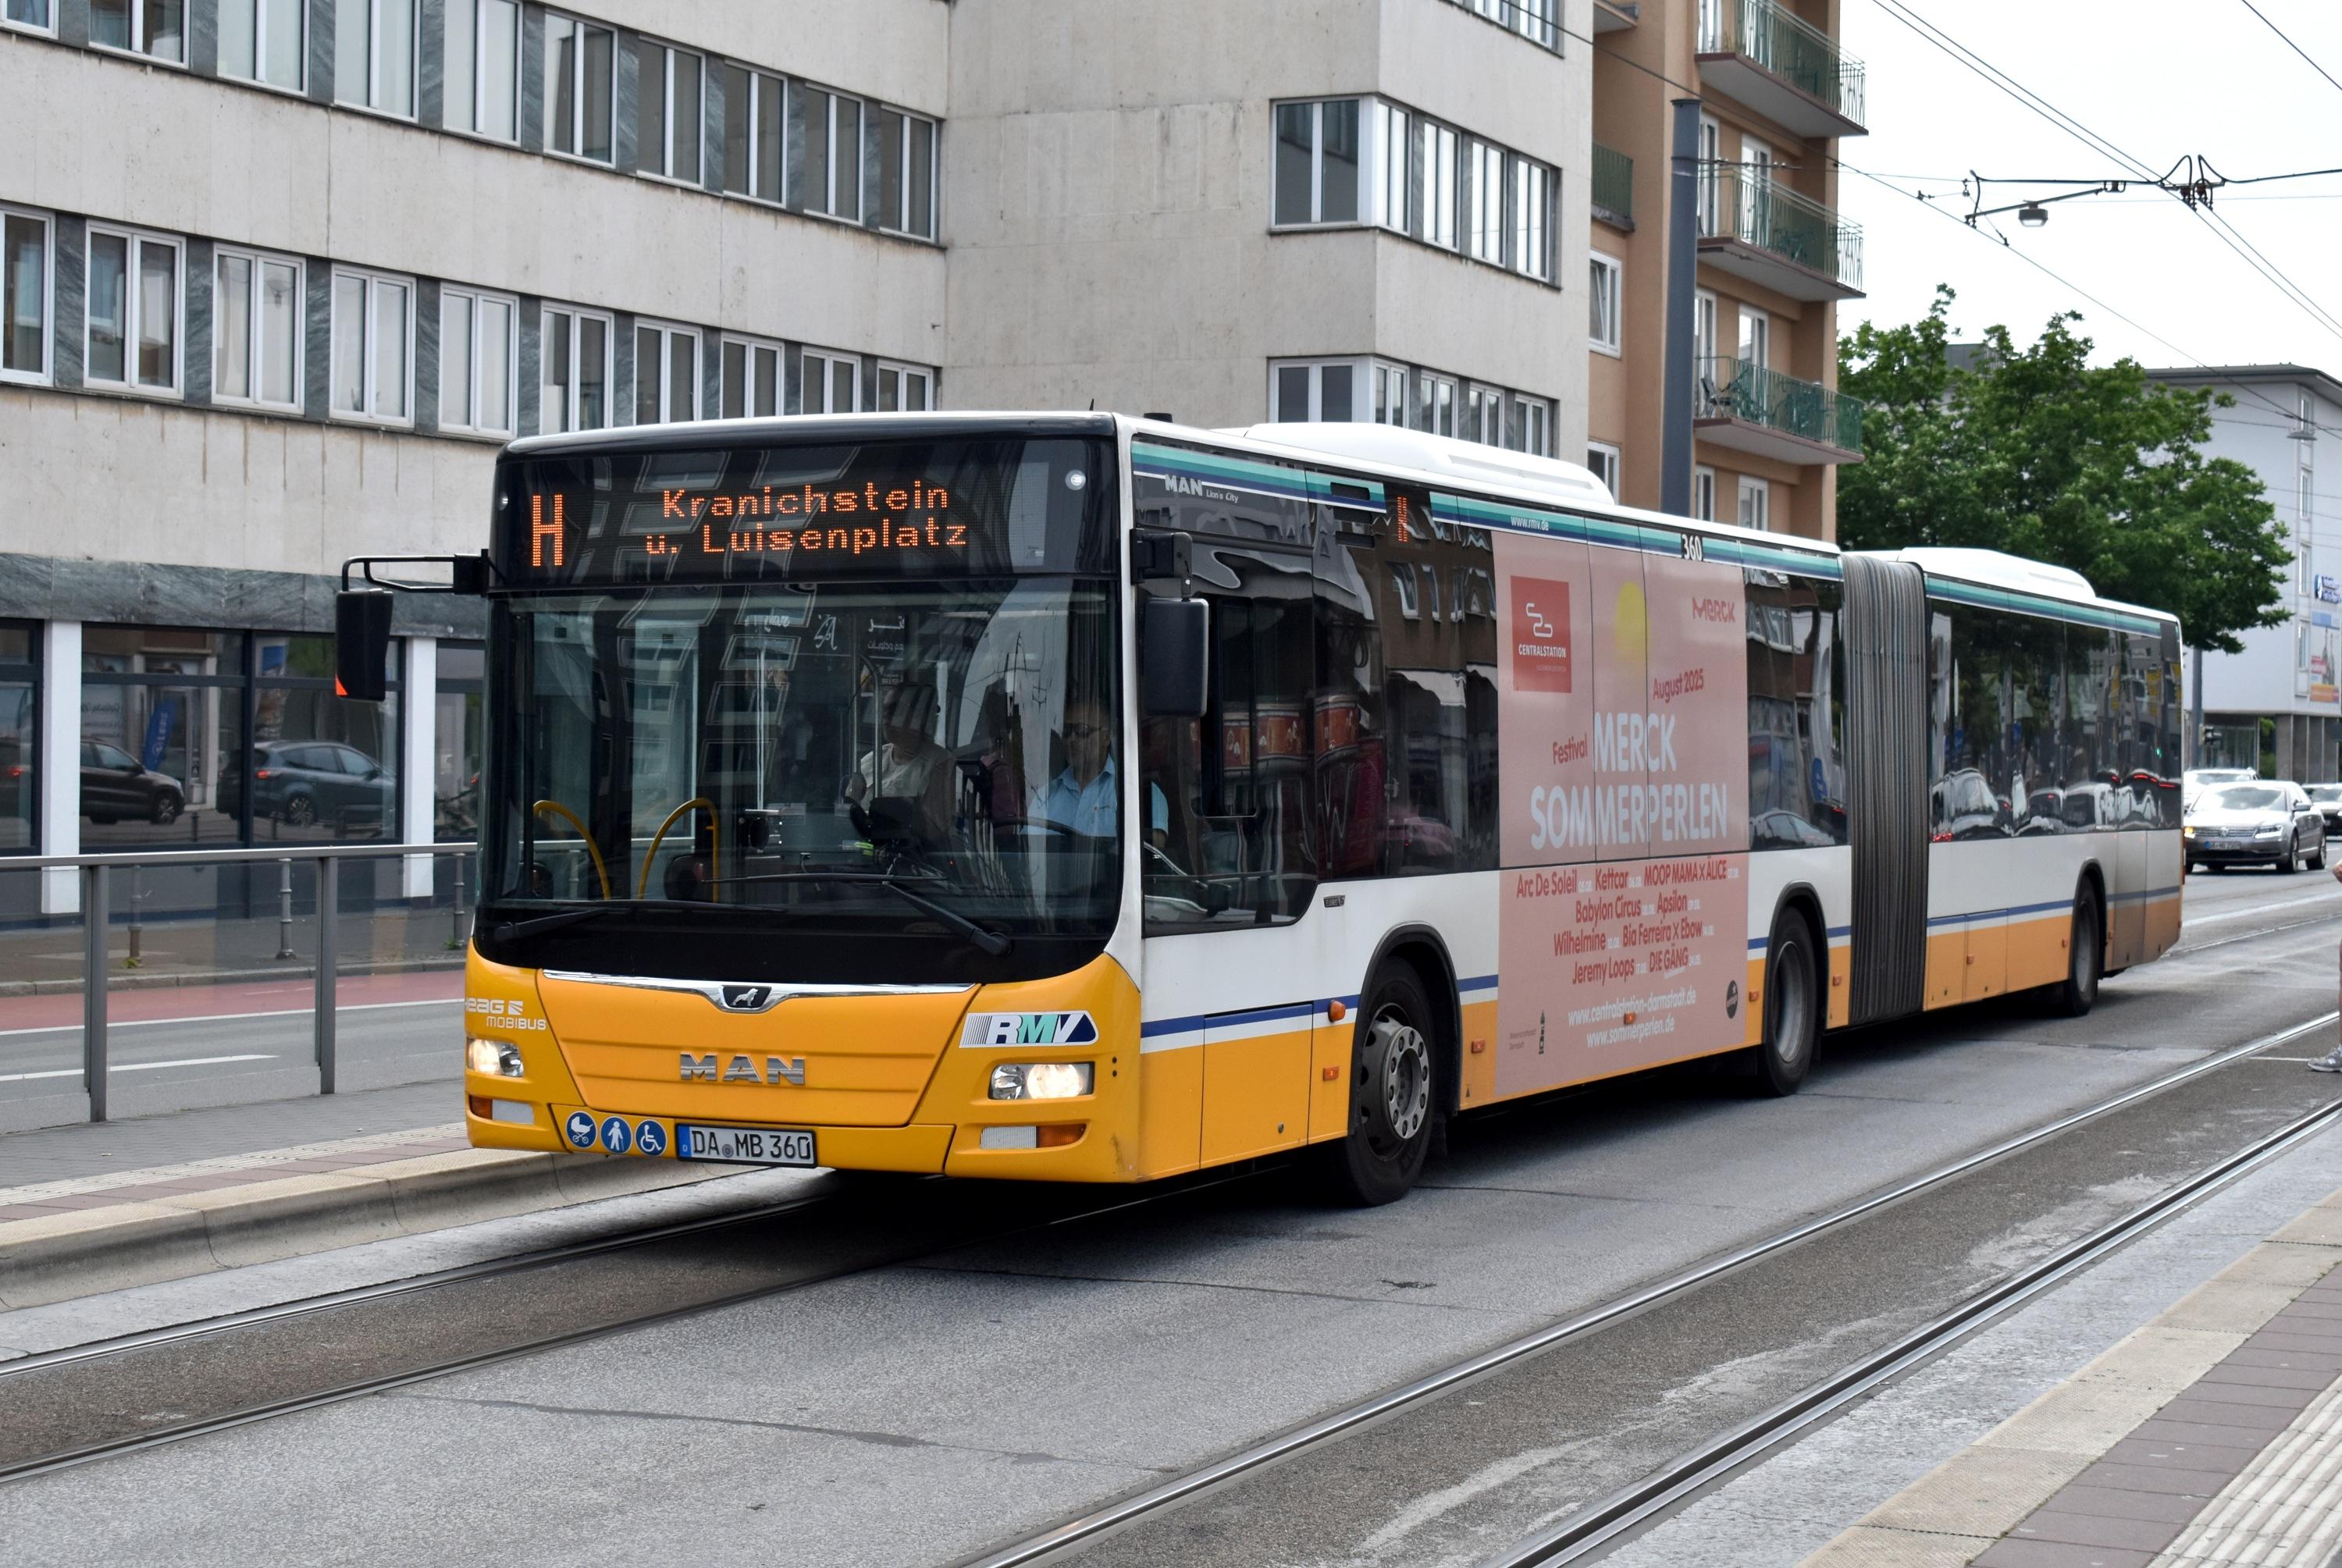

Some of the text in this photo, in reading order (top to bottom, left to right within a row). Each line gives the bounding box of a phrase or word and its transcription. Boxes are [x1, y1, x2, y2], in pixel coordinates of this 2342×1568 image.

[664, 480, 949, 518] Kranichstein
[1166, 475, 1202, 496] MAN
[1226, 492, 1239, 503] City
[532, 494, 562, 566] H
[646, 517, 967, 555] ü. Luisenplatz
[1511, 516, 1549, 532] www.rmv.de
[1682, 534, 1703, 561] 360
[1518, 644, 1566, 658] CENTRALSTATION
[1653, 668, 1704, 704] August 2025
[1552, 733, 1588, 766] Festival
[1594, 712, 1677, 773] MERCK
[1530, 783, 1728, 850] SOMMERPERLEN
[1517, 874, 1533, 898] Arc
[1536, 873, 1550, 896] De
[1552, 869, 1577, 895] Soleil
[1596, 868, 1629, 891] Kettcar
[1644, 863, 1671, 887] MOOP
[1672, 861, 1698, 884] MAMA
[1575, 898, 1613, 927] Babylon
[1615, 894, 1641, 919] Circus
[1657, 890, 1687, 919] Apsilon
[1554, 927, 1606, 956] Wilhelmine
[1623, 923, 1637, 947] Bia
[1638, 919, 1671, 945] Ferreira
[1681, 917, 1702, 940] Ebow
[1572, 961, 1607, 987] Jeremy
[1609, 955, 1635, 983] Loops
[1664, 943, 1689, 969] GÄNG
[487, 1015, 546, 1030] MOBIBUS
[984, 1014, 1084, 1044] RMV
[1586, 1015, 1675, 1048] www.sommerperlen.de
[680, 1051, 806, 1085] MAN
[692, 1130, 720, 1155] DA
[735, 1132, 763, 1157] MB
[769, 1135, 811, 1160] 360
